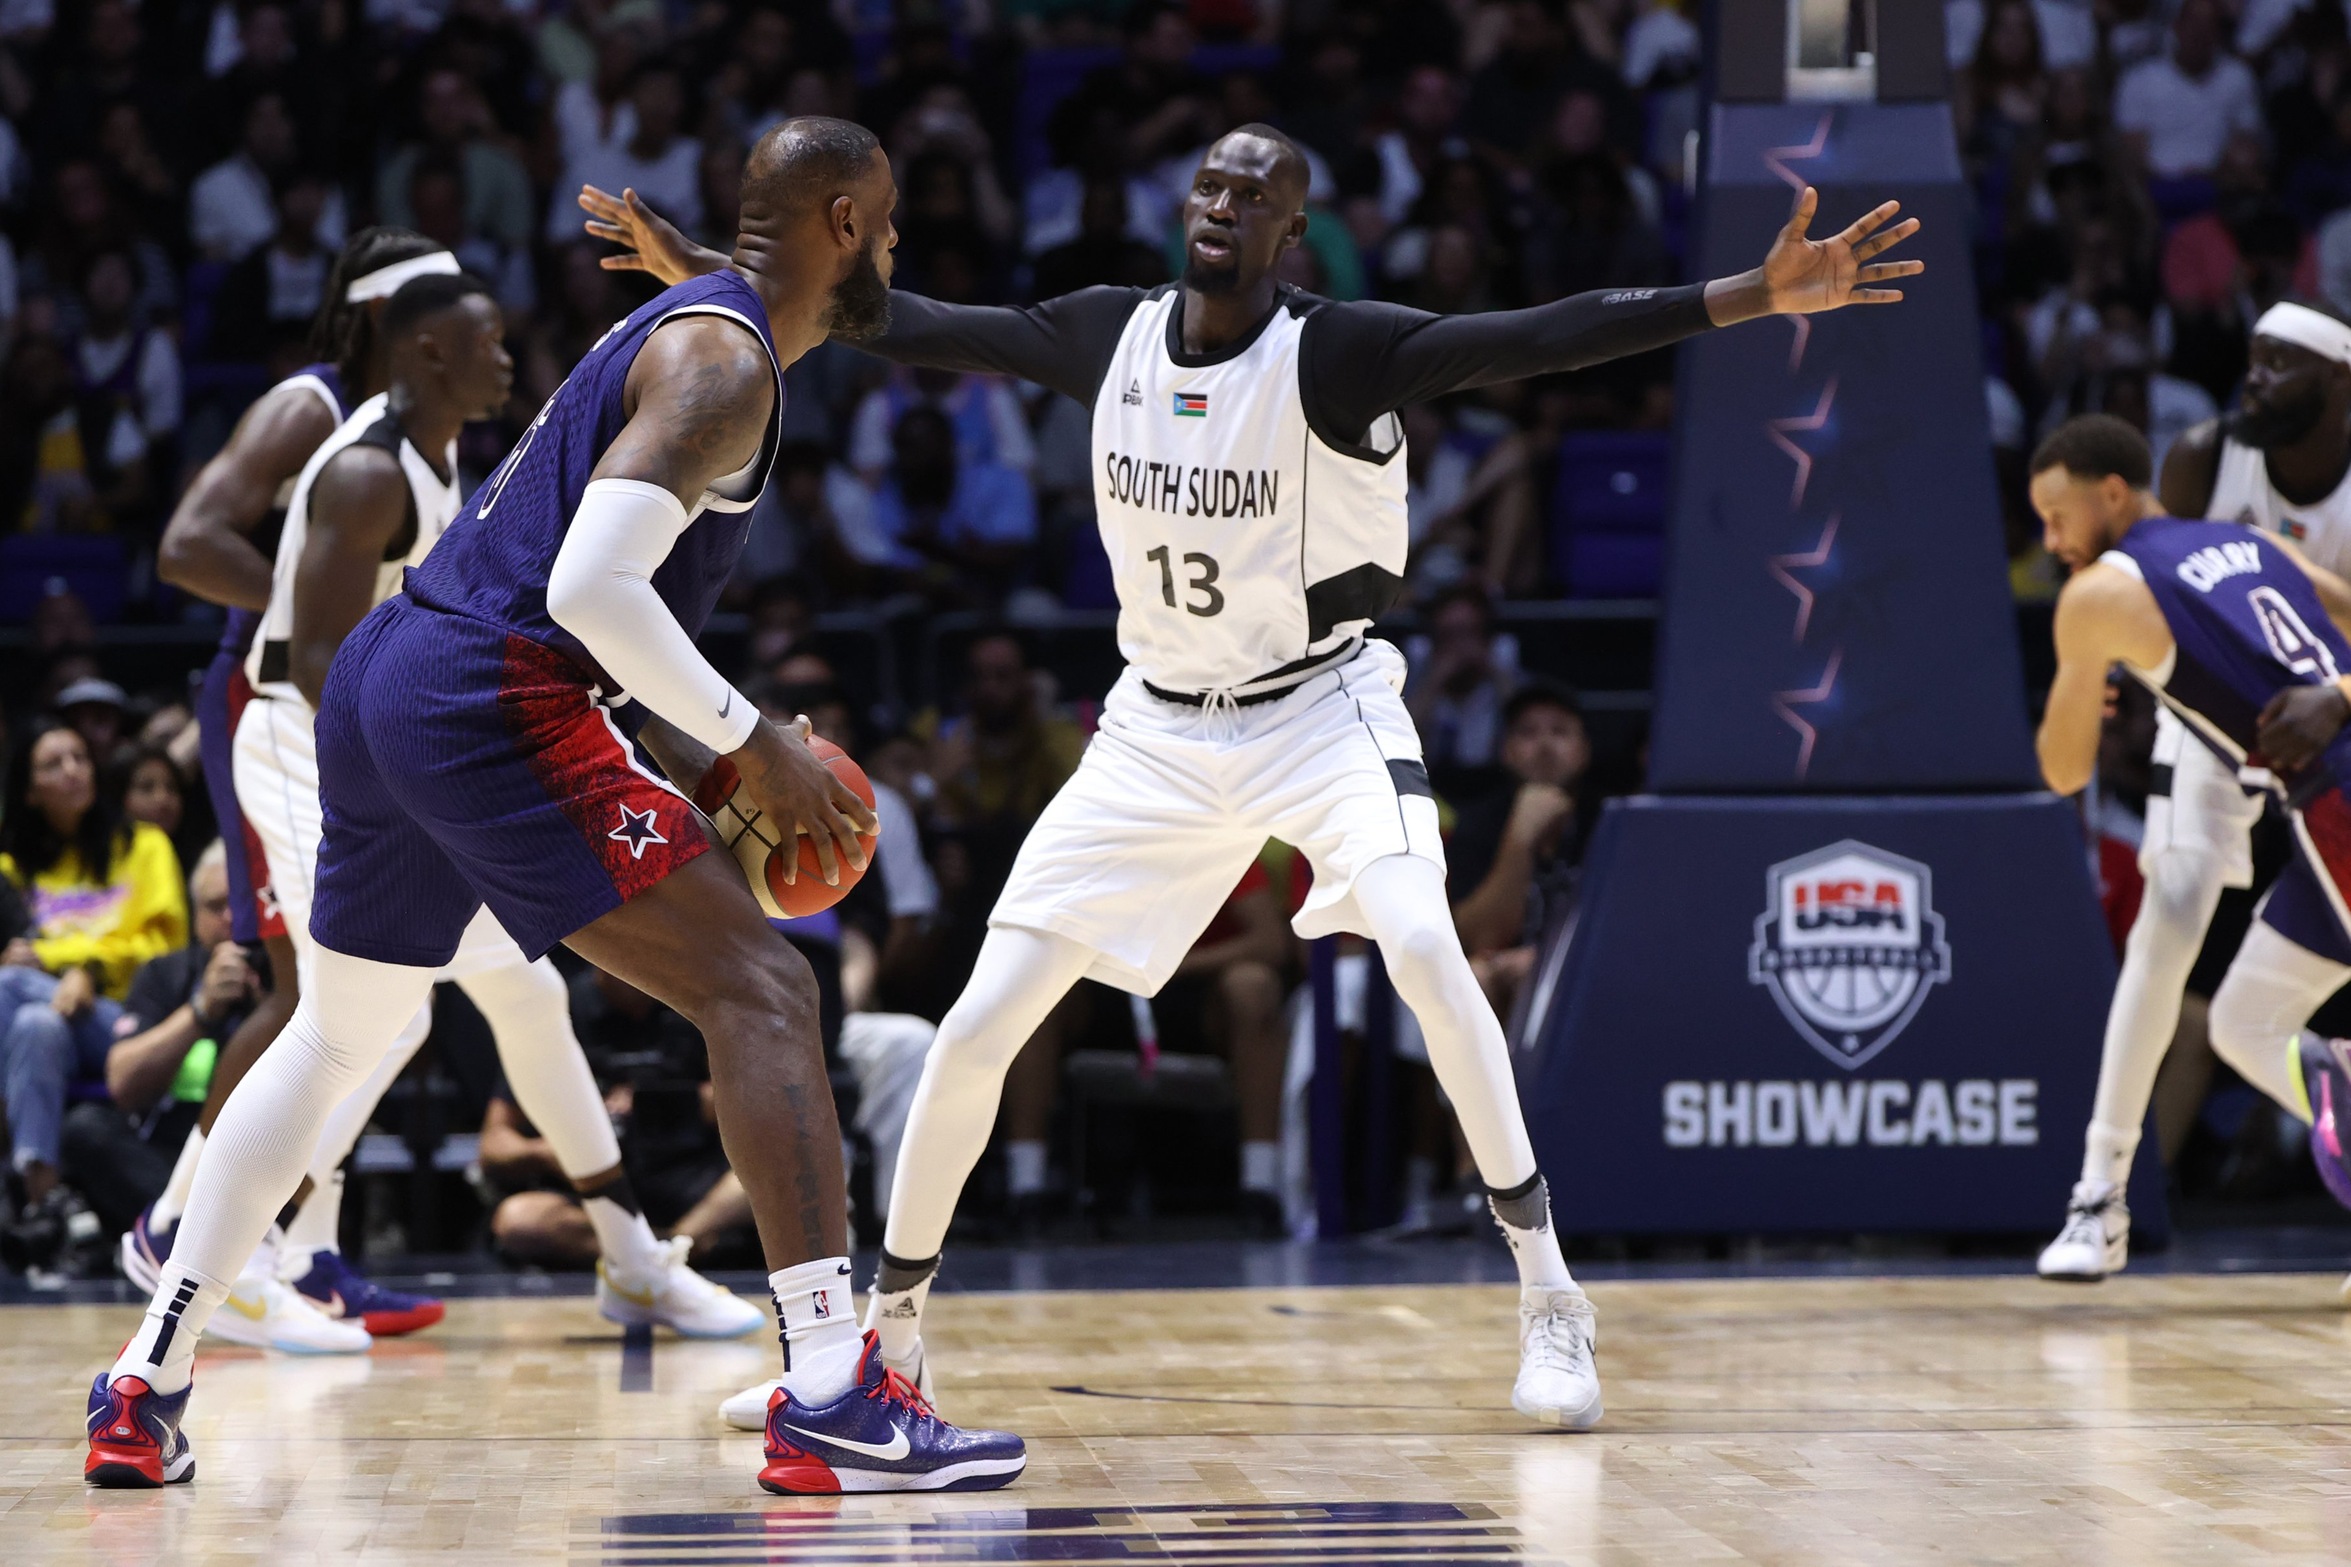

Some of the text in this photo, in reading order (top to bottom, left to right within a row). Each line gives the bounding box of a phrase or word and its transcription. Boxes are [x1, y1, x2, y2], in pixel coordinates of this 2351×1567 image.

[1107, 452, 1278, 518] SOUTH SUDAN
[1146, 545, 1224, 617] 13
[2177, 541, 2262, 593] CURRY
[2247, 586, 2341, 686] 4
[1795, 881, 1905, 931] USA
[1663, 1081, 2039, 1147] SHOWCASE
